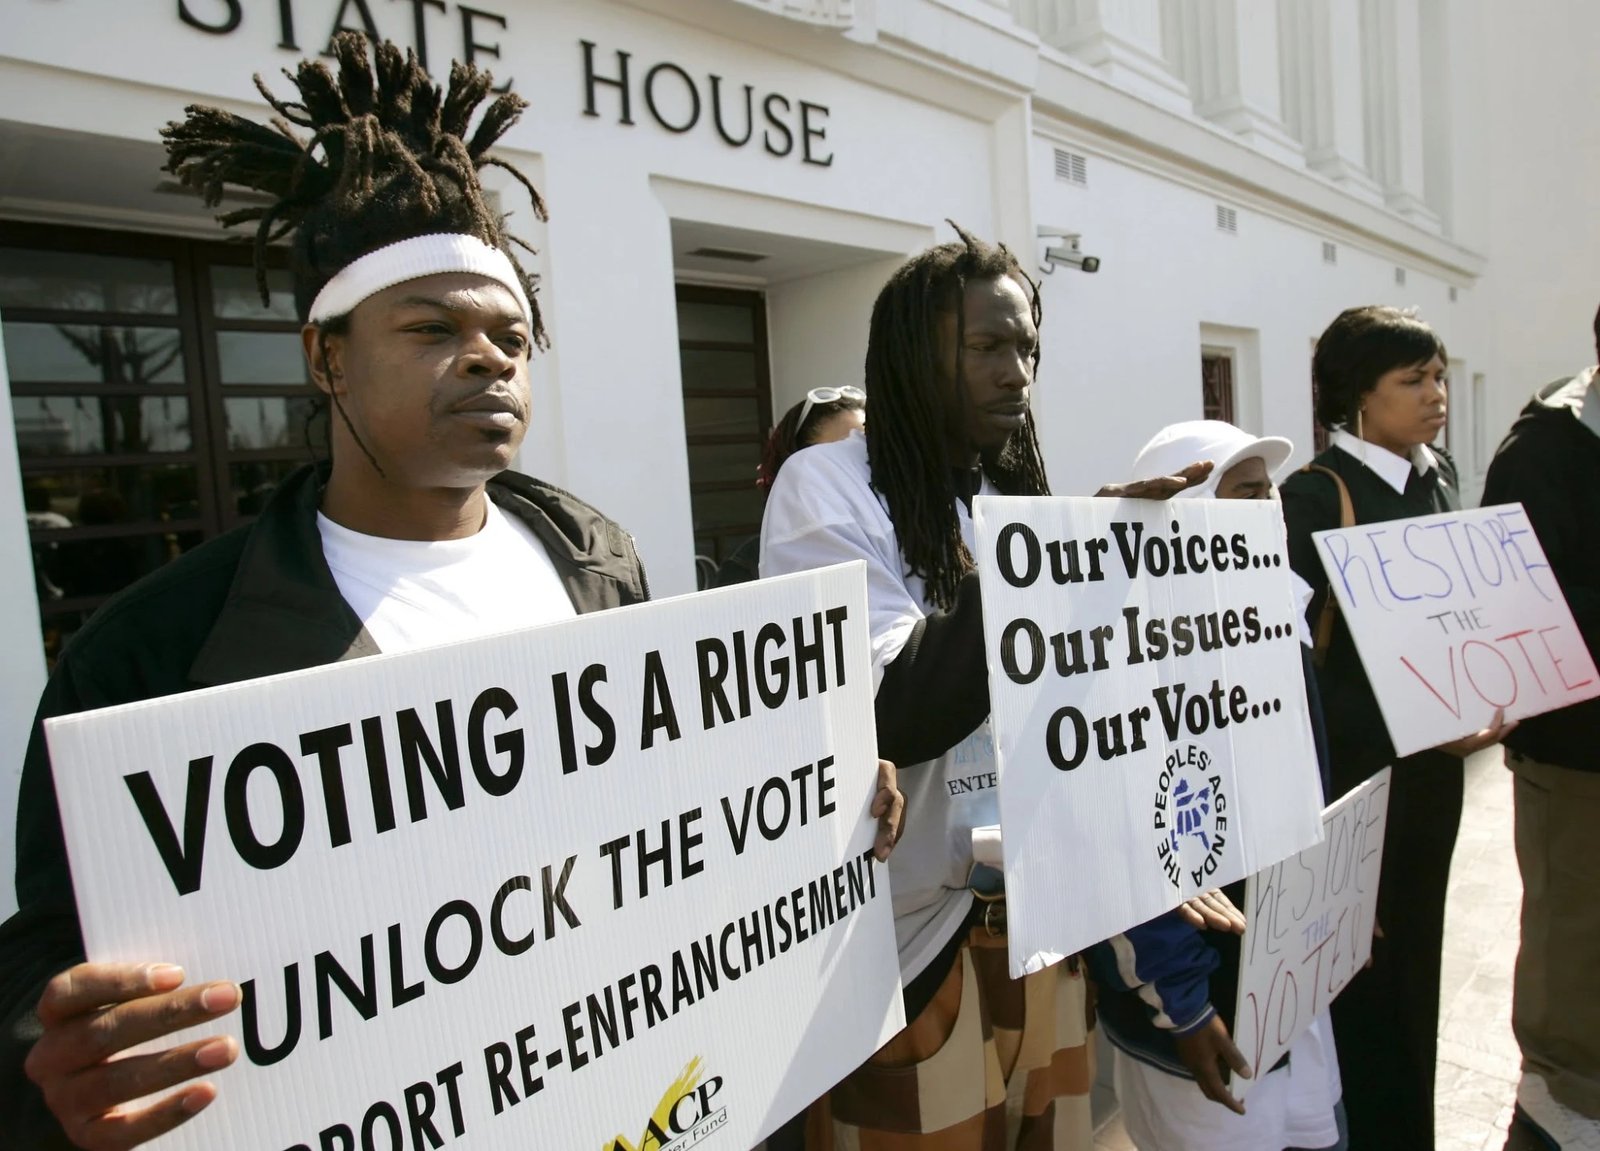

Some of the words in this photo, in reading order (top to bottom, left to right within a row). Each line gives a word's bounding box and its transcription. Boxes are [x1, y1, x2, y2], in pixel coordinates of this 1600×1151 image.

[579, 39, 834, 167] HOUSE
[996, 522, 1108, 588] Our
[1110, 519, 1282, 579] Voices...
[1324, 510, 1553, 612] RESTORE
[1000, 617, 1114, 685] Our
[1122, 604, 1293, 666] Issues...
[1426, 607, 1492, 634] THE
[1400, 626, 1593, 720] VOTE
[123, 686, 526, 897] VOTING
[551, 663, 617, 775] IS
[640, 649, 681, 751] A
[695, 605, 848, 731] RIGHT
[1045, 705, 1151, 772] Our
[1152, 679, 1282, 743] Vote...
[1154, 744, 1212, 830] PEOPLES'
[1191, 775, 1227, 888] AGENDA
[1157, 838, 1181, 889] THE
[239, 854, 582, 1067] UNLOCK
[599, 806, 704, 911] THE
[720, 755, 836, 857] VOTE
[1302, 909, 1333, 950] THE
[483, 848, 876, 1117] RE-ENFRANCHISEMENT
[692, 1108, 728, 1141] Fund
